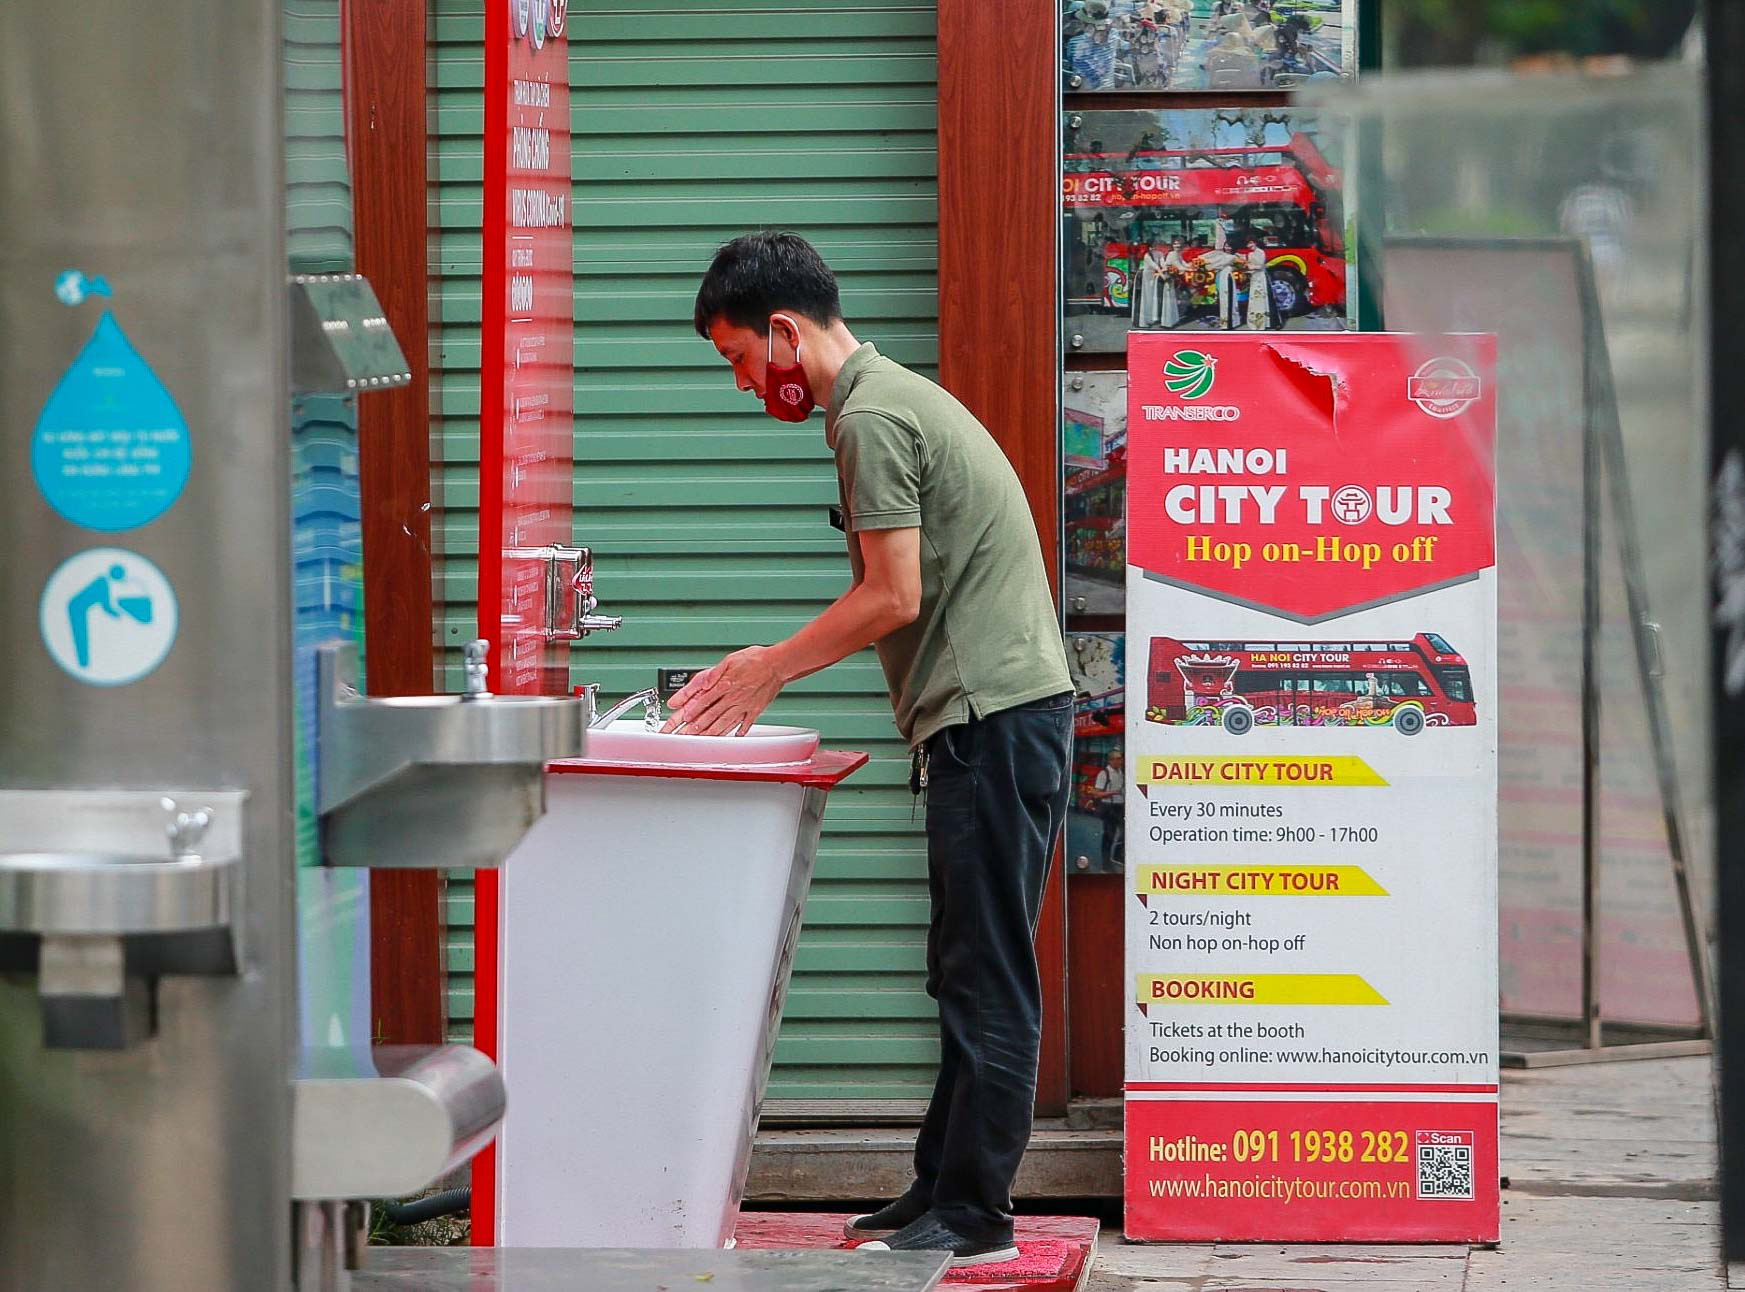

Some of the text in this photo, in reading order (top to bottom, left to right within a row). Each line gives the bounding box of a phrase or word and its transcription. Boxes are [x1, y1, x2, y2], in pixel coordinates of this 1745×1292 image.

[1142, 404, 1240, 422] TRANSERCO
[1162, 447, 1288, 475] HANOI
[1163, 483, 1454, 526] CITY TOUR
[1185, 535, 1439, 570] Hop on-Hop off
[1250, 653, 1350, 662] HA NOI CITY TOUR
[1151, 762, 1334, 781] DAILY CITY TOUR
[1149, 801, 1283, 821] Every 30 minutes
[1149, 826, 1229, 846] Operation
[1232, 826, 1273, 843] time:
[1275, 826, 1316, 843] 9h00
[1329, 826, 1379, 843] 17h00
[1151, 871, 1340, 891] NIGHT CITY TOUR
[1149, 910, 1252, 930] 2 tours/night
[1149, 934, 1306, 954] Non hop on-hop off
[1151, 980, 1255, 999] BOOKING
[1149, 1022, 1305, 1039] Tickets at the booth
[1149, 1047, 1489, 1068] Booking online: www.hanoicitytour.com.vn
[1149, 1130, 1410, 1163] Hotline: 091 1938 282
[1430, 1132, 1462, 1144] Scan
[1149, 1174, 1410, 1204] www.hanoicitytour.com.vn
